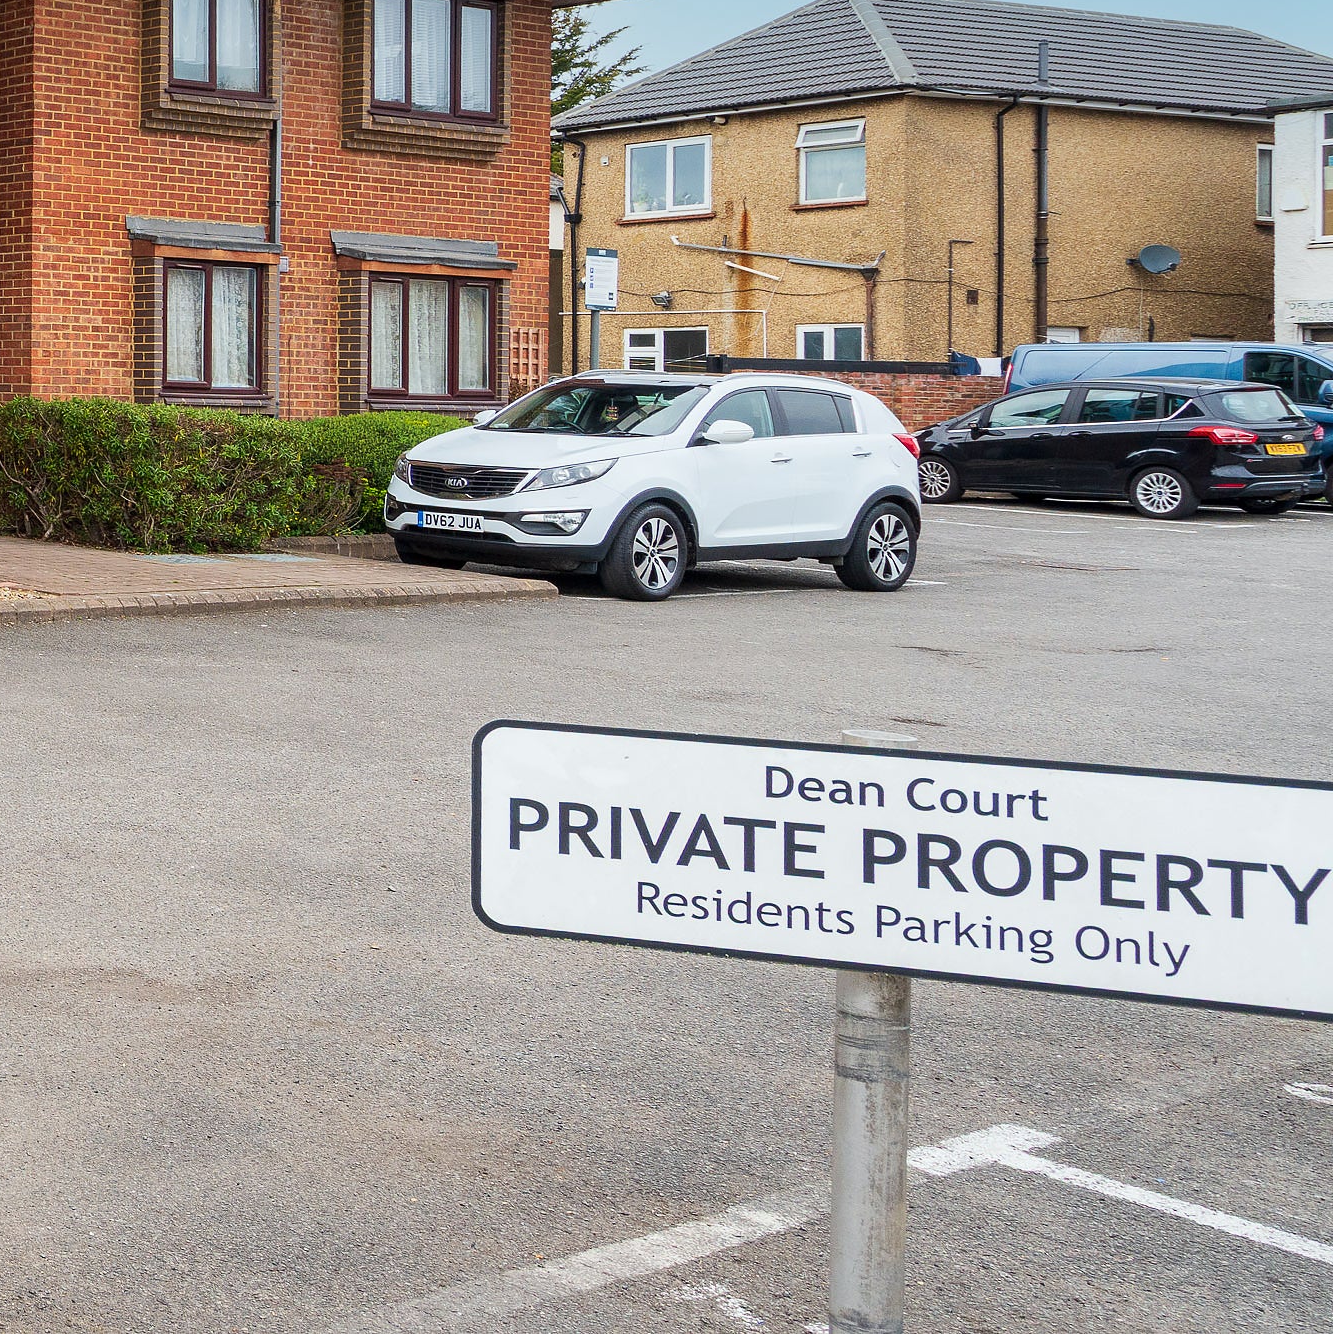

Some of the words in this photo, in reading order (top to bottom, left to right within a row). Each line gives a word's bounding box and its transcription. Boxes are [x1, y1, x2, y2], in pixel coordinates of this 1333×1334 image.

[447, 478, 463, 487] KIA
[425, 514, 455, 527] DV62
[458, 517, 482, 530] JUA
[764, 765, 885, 808] Dean
[906, 777, 1049, 822] Court
[509, 797, 826, 880] PRIVATE
[862, 828, 1332, 926] PROPERTY
[636, 881, 855, 935] Residents
[875, 904, 1055, 964] Parking
[1075, 925, 1191, 977] Only
